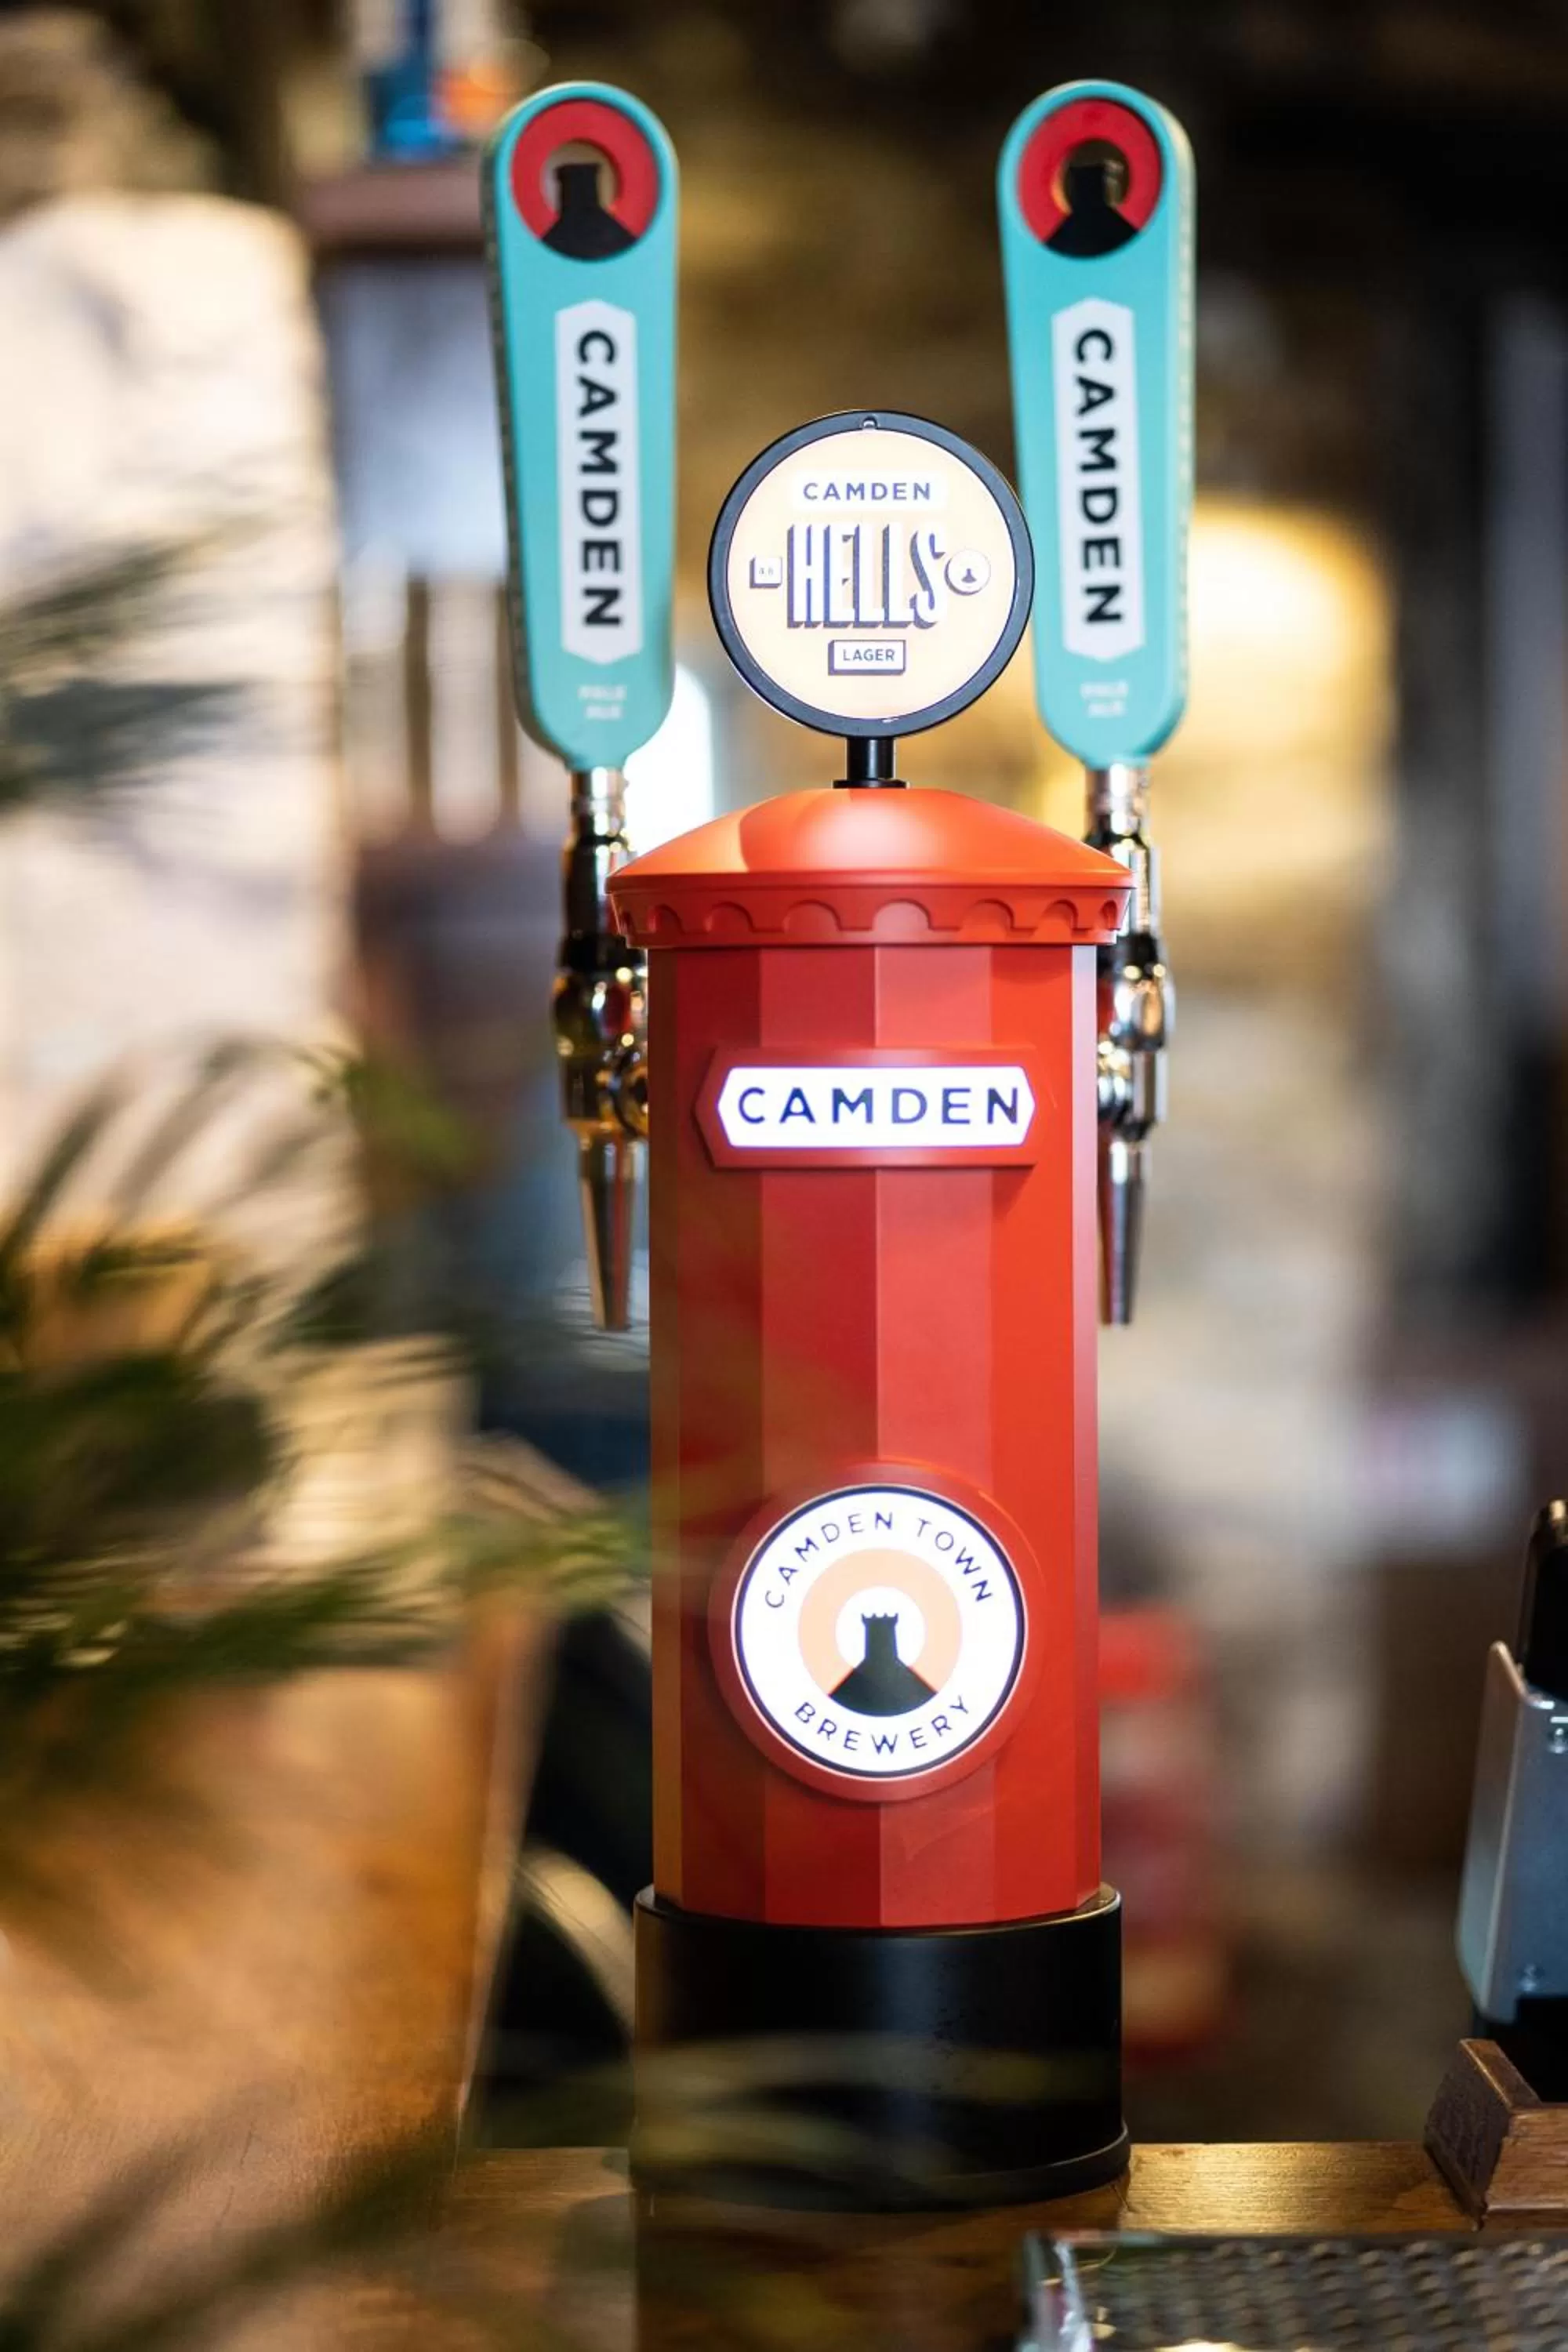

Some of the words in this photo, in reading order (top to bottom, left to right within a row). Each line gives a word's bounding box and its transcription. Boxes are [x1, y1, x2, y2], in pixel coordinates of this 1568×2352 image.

[575, 329, 624, 628] CAMDEN
[802, 481, 931, 501] CAMDEN
[1073, 328, 1123, 625] CAMDEN
[786, 524, 946, 630] HELLS
[842, 648, 895, 662] LAGER
[738, 1087, 1018, 1125] CAMDEN
[764, 1512, 894, 1610] CAMDEN
[916, 1517, 993, 1603] TOWN
[793, 1695, 970, 1755] BREWERY
